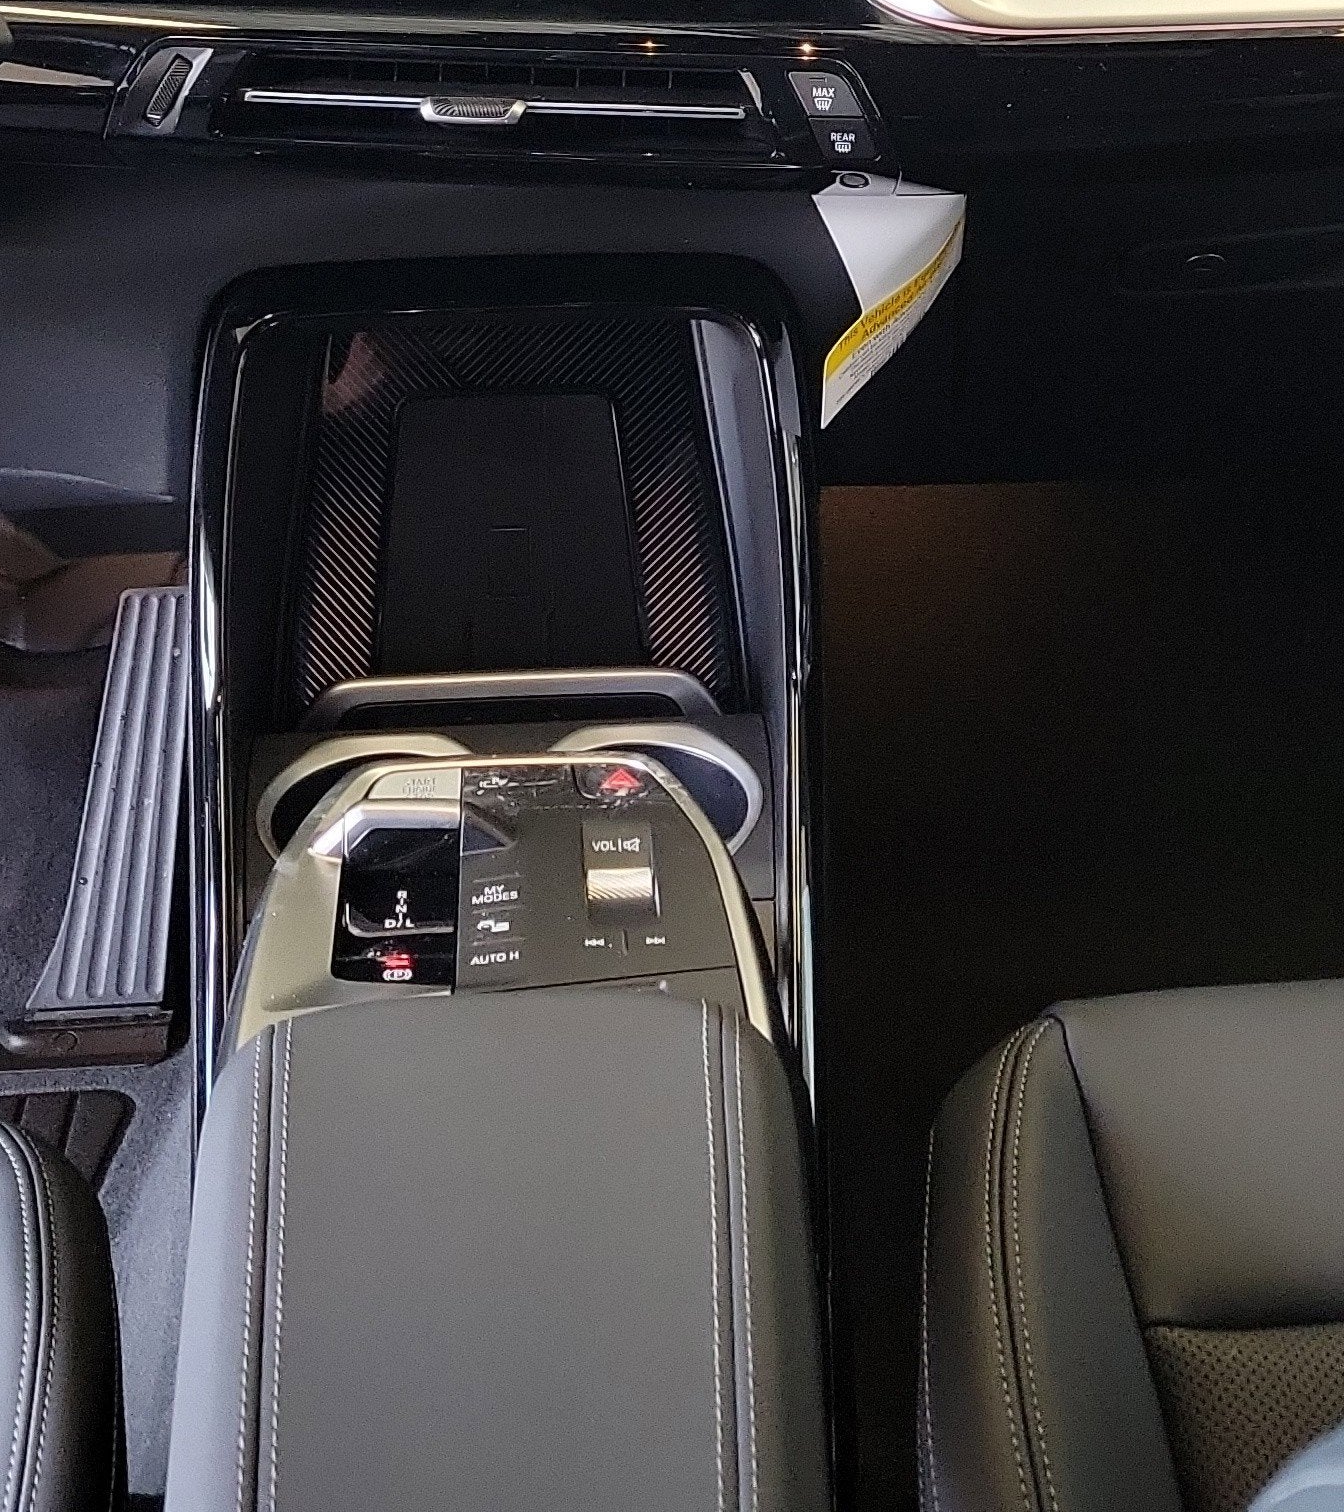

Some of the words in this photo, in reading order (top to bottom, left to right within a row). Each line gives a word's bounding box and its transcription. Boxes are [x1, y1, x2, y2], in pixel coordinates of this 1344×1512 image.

[812, 86, 835, 98] MAX
[830, 132, 855, 143] REAR
[591, 839, 617, 852] VOL
[484, 884, 505, 896] MY
[471, 891, 519, 905] MODES
[395, 904, 408, 914] N
[470, 952, 507, 966] AUTO
[509, 950, 520, 961] H
